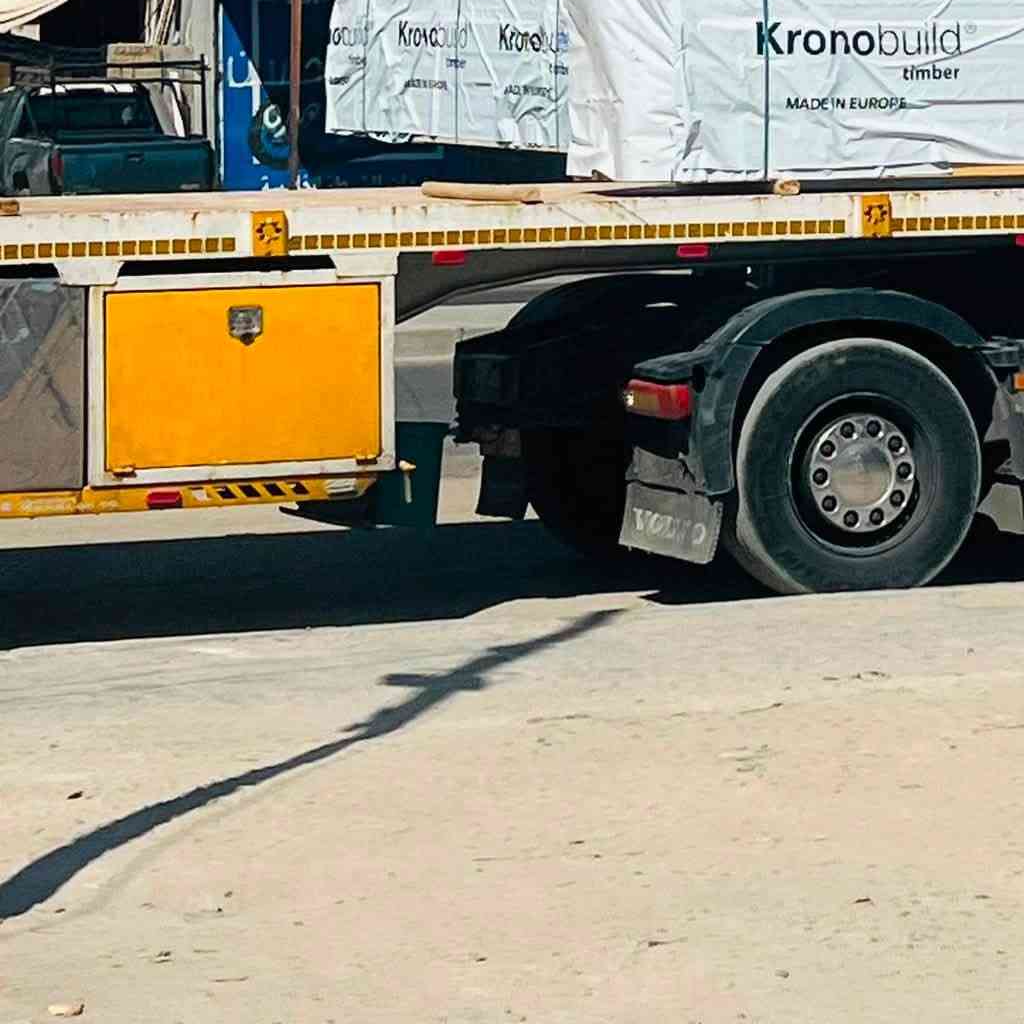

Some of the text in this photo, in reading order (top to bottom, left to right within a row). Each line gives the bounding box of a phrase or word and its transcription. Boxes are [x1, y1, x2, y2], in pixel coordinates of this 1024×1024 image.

[755, 20, 962, 57] Kronobuild
[902, 64, 960, 81] timber
[785, 97, 908, 111] MADE IN EUROPE
